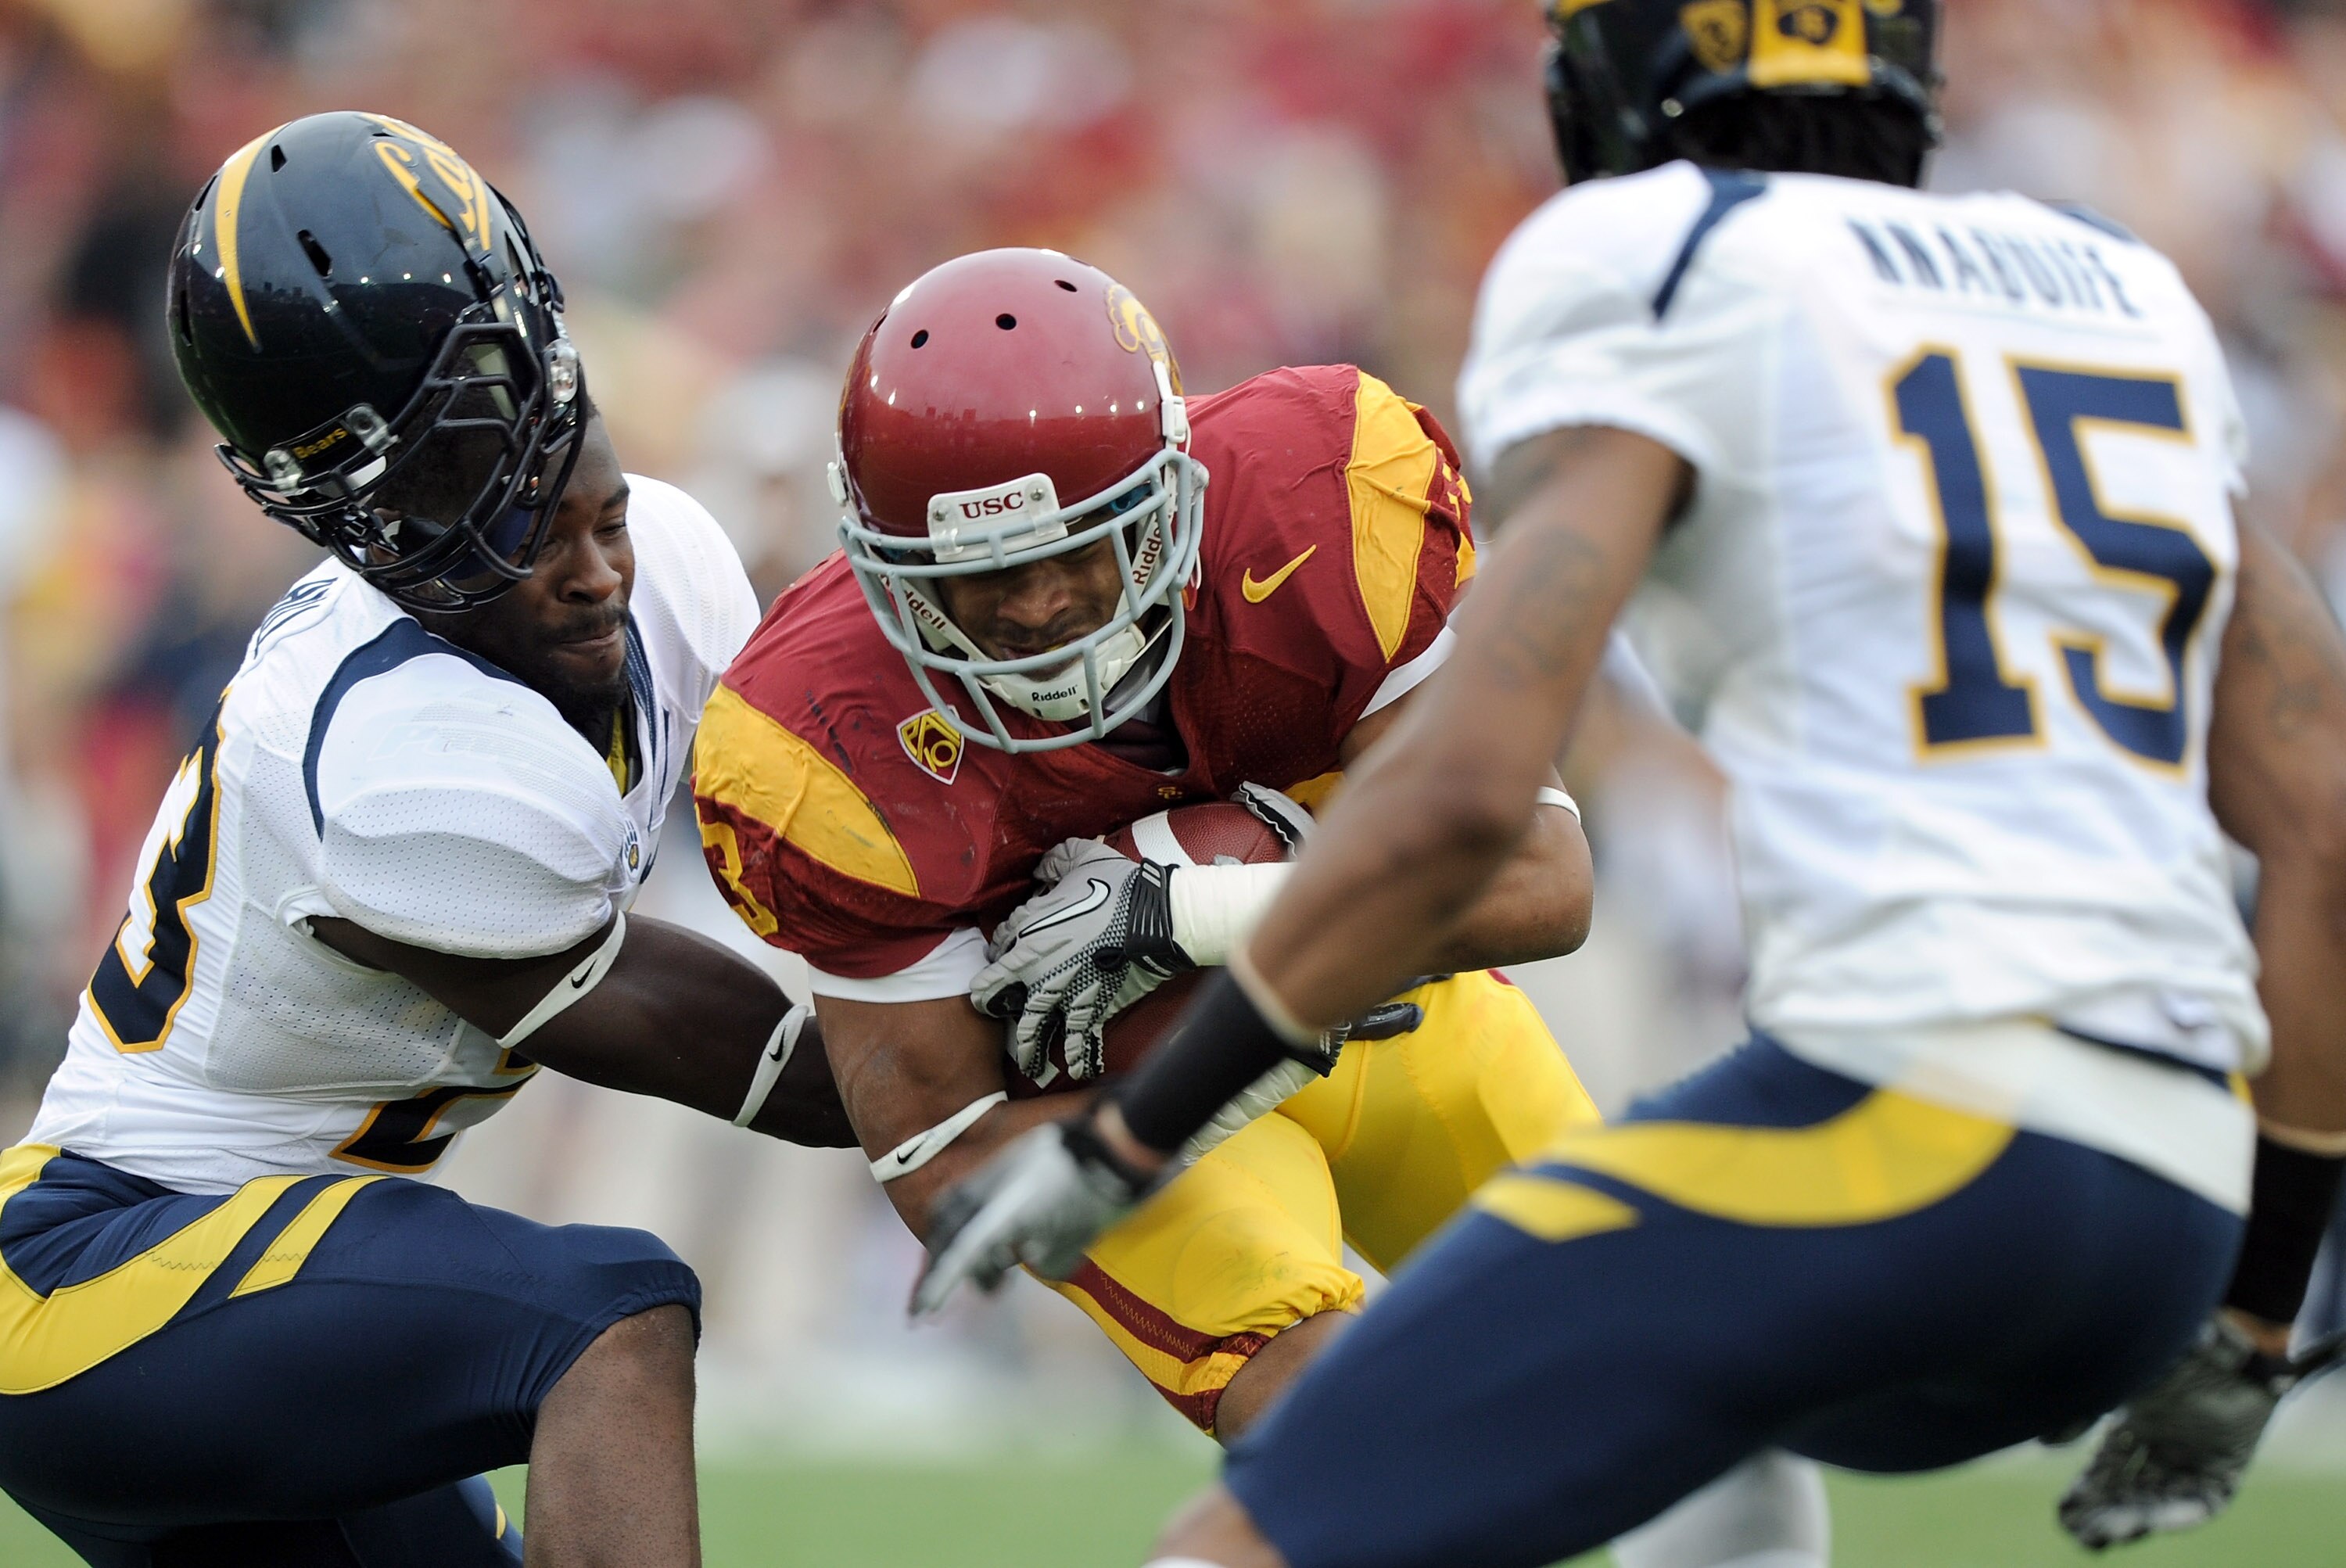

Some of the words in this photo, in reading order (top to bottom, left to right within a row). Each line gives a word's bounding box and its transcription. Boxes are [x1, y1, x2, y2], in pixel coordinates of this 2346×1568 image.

[292, 428, 349, 459] Bears
[959, 490, 1024, 519] USC
[1880, 341, 2219, 779] 15
[1031, 686, 1077, 702] Riddell
